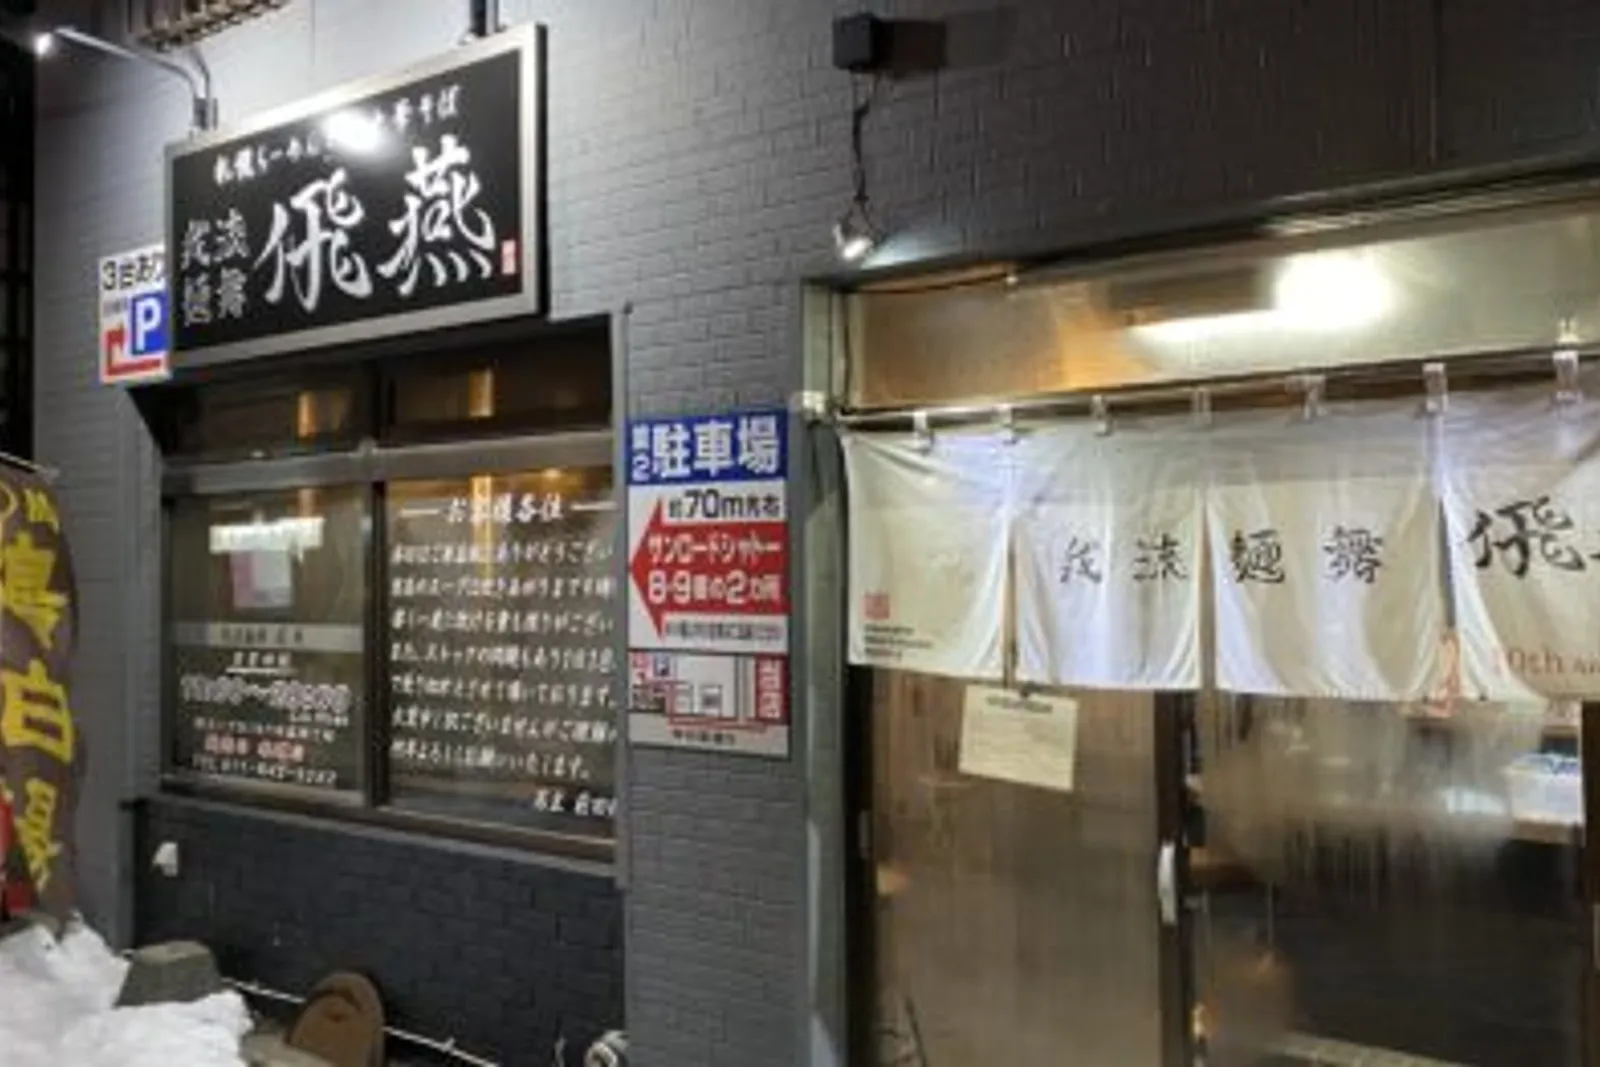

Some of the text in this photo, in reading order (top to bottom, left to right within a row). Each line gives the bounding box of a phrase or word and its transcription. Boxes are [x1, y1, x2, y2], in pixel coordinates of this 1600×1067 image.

[253, 133, 496, 313] 飛燕
[135, 297, 162, 352] P
[652, 414, 780, 480] 駐車場
